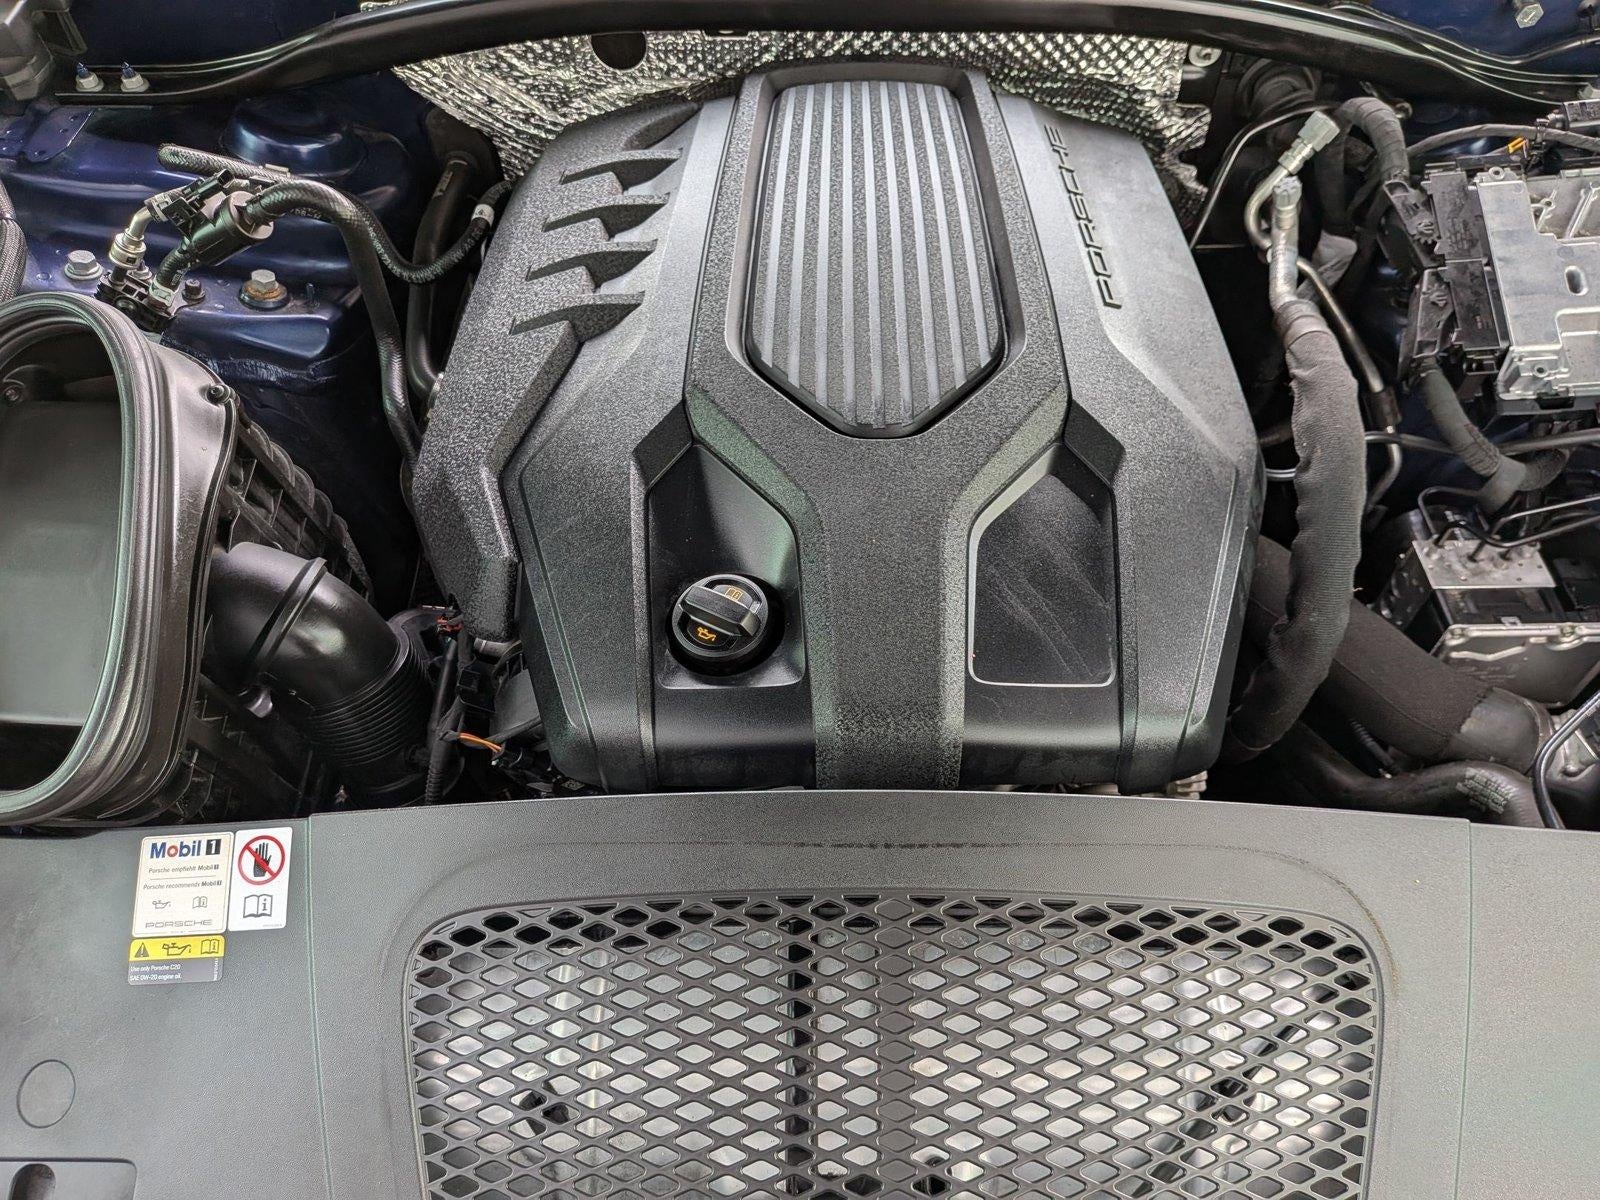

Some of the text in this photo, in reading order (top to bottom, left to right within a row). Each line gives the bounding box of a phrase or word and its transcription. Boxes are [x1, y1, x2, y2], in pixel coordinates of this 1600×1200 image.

[1044, 124, 1122, 309] PORSCHE
[150, 840, 202, 859] Mobil
[145, 920, 213, 928] PORSCHE
